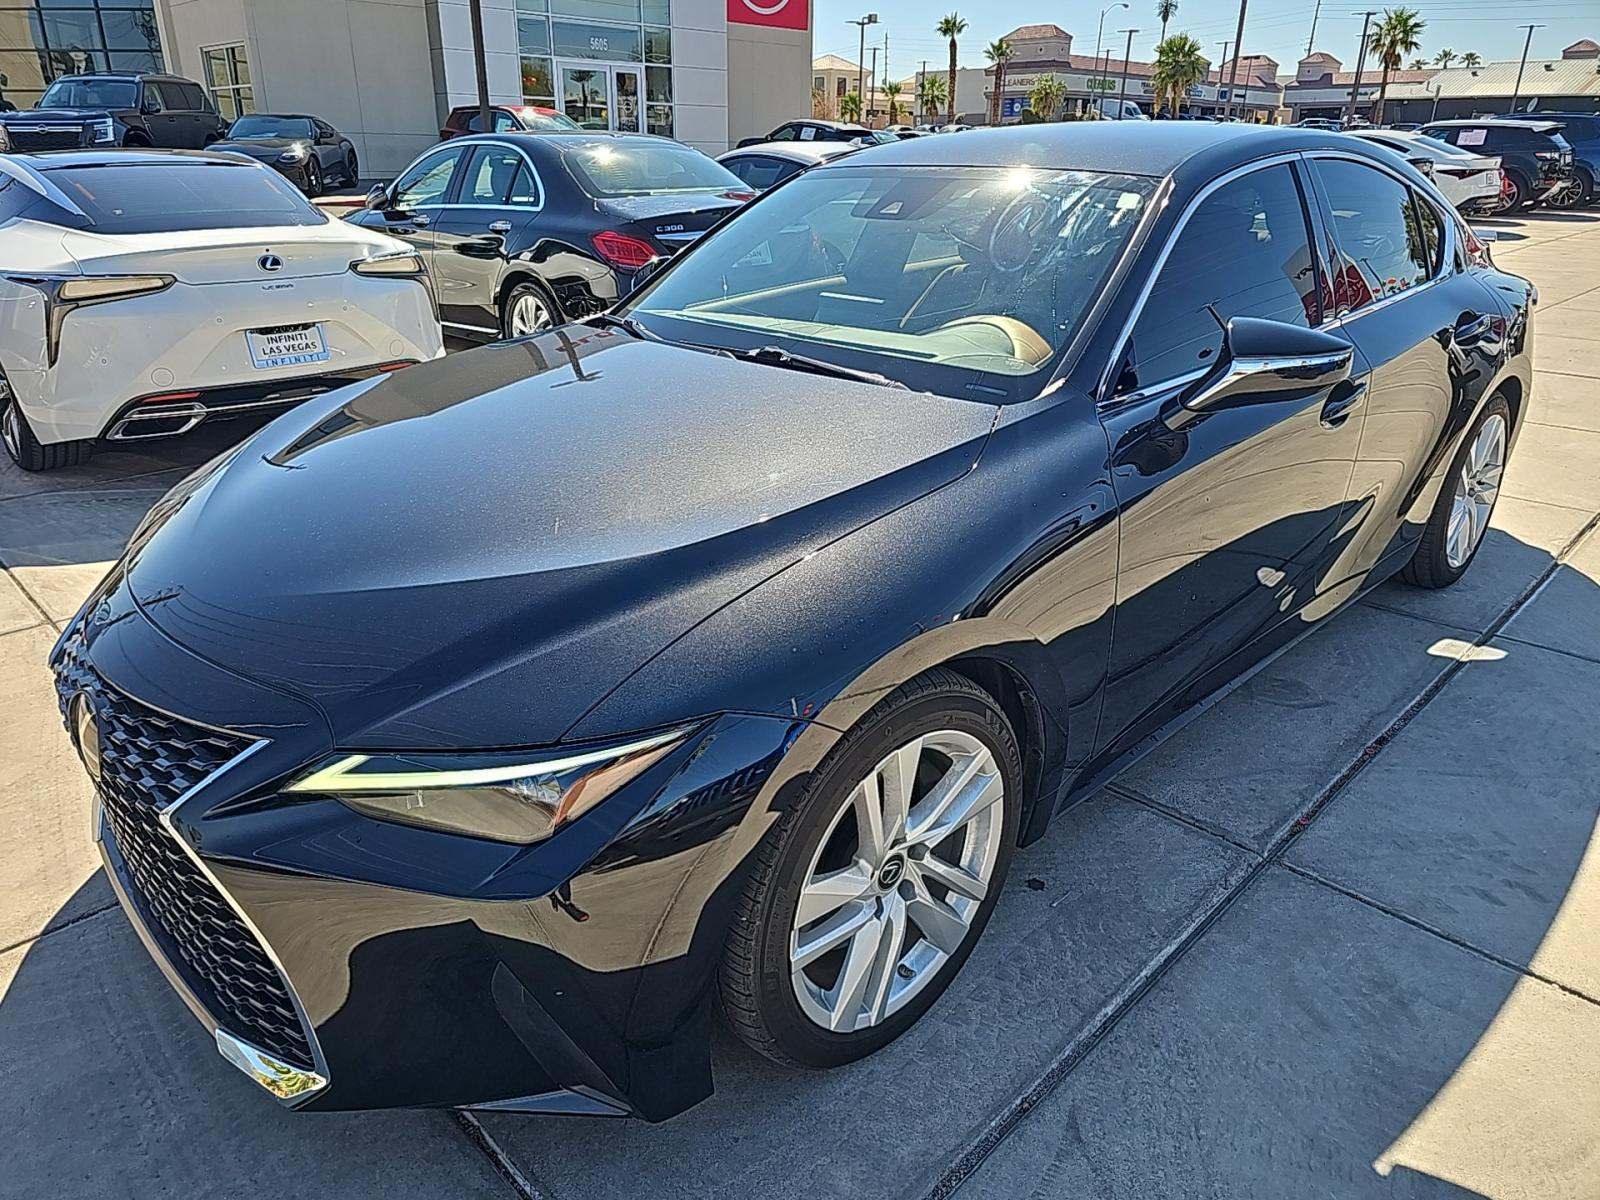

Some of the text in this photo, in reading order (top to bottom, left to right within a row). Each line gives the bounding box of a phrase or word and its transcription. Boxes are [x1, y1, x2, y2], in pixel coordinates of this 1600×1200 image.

[590, 37, 608, 51] 5605
[267, 332, 308, 344] INFINITI
[262, 340, 318, 356] LAS VEGAS
